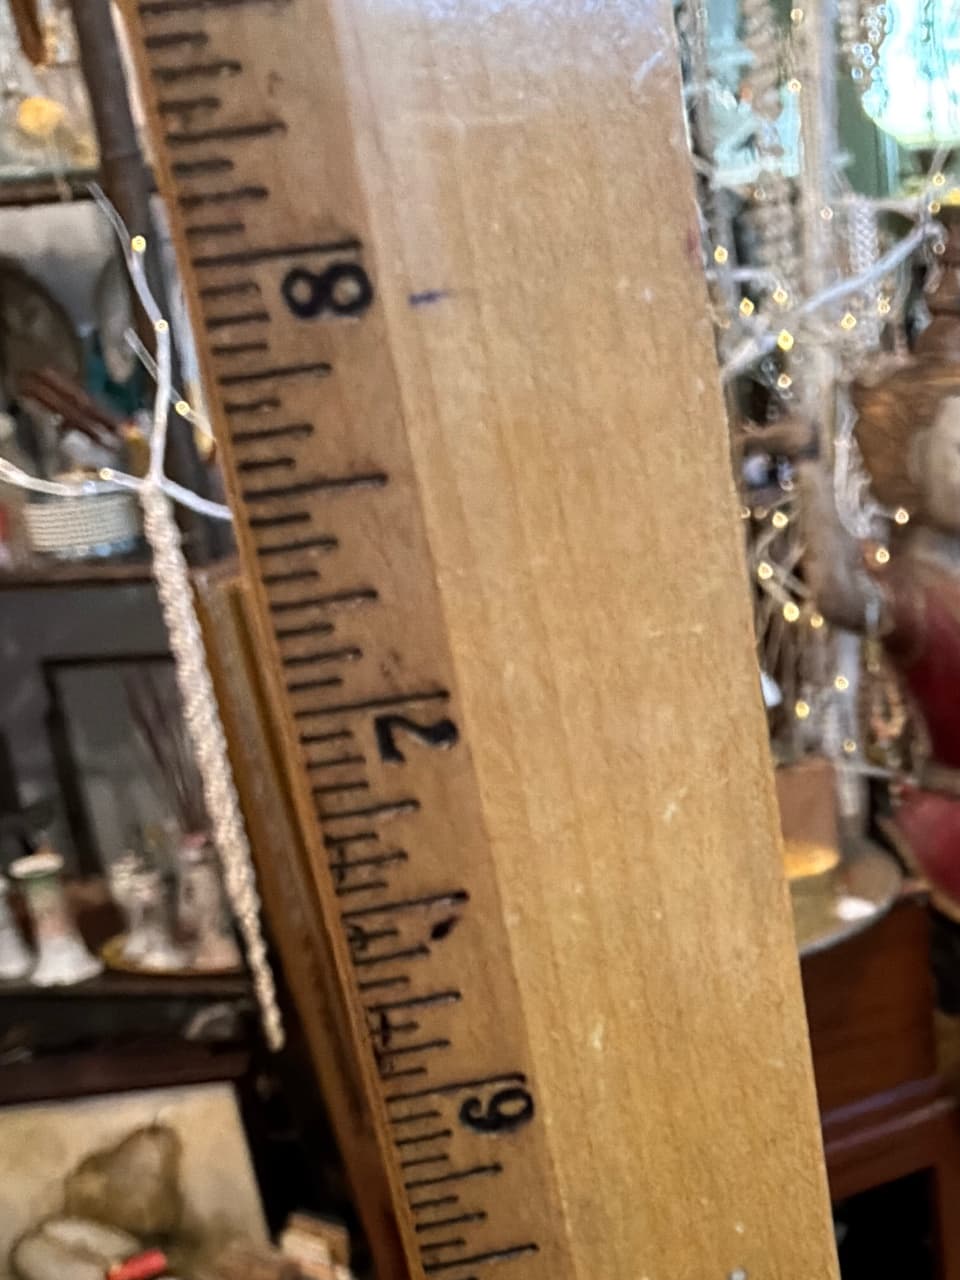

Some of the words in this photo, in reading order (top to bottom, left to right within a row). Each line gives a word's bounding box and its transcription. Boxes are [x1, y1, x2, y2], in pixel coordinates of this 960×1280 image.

[282, 262, 373, 319] 8
[374, 715, 459, 763] 7
[459, 1088, 534, 1132] 6
